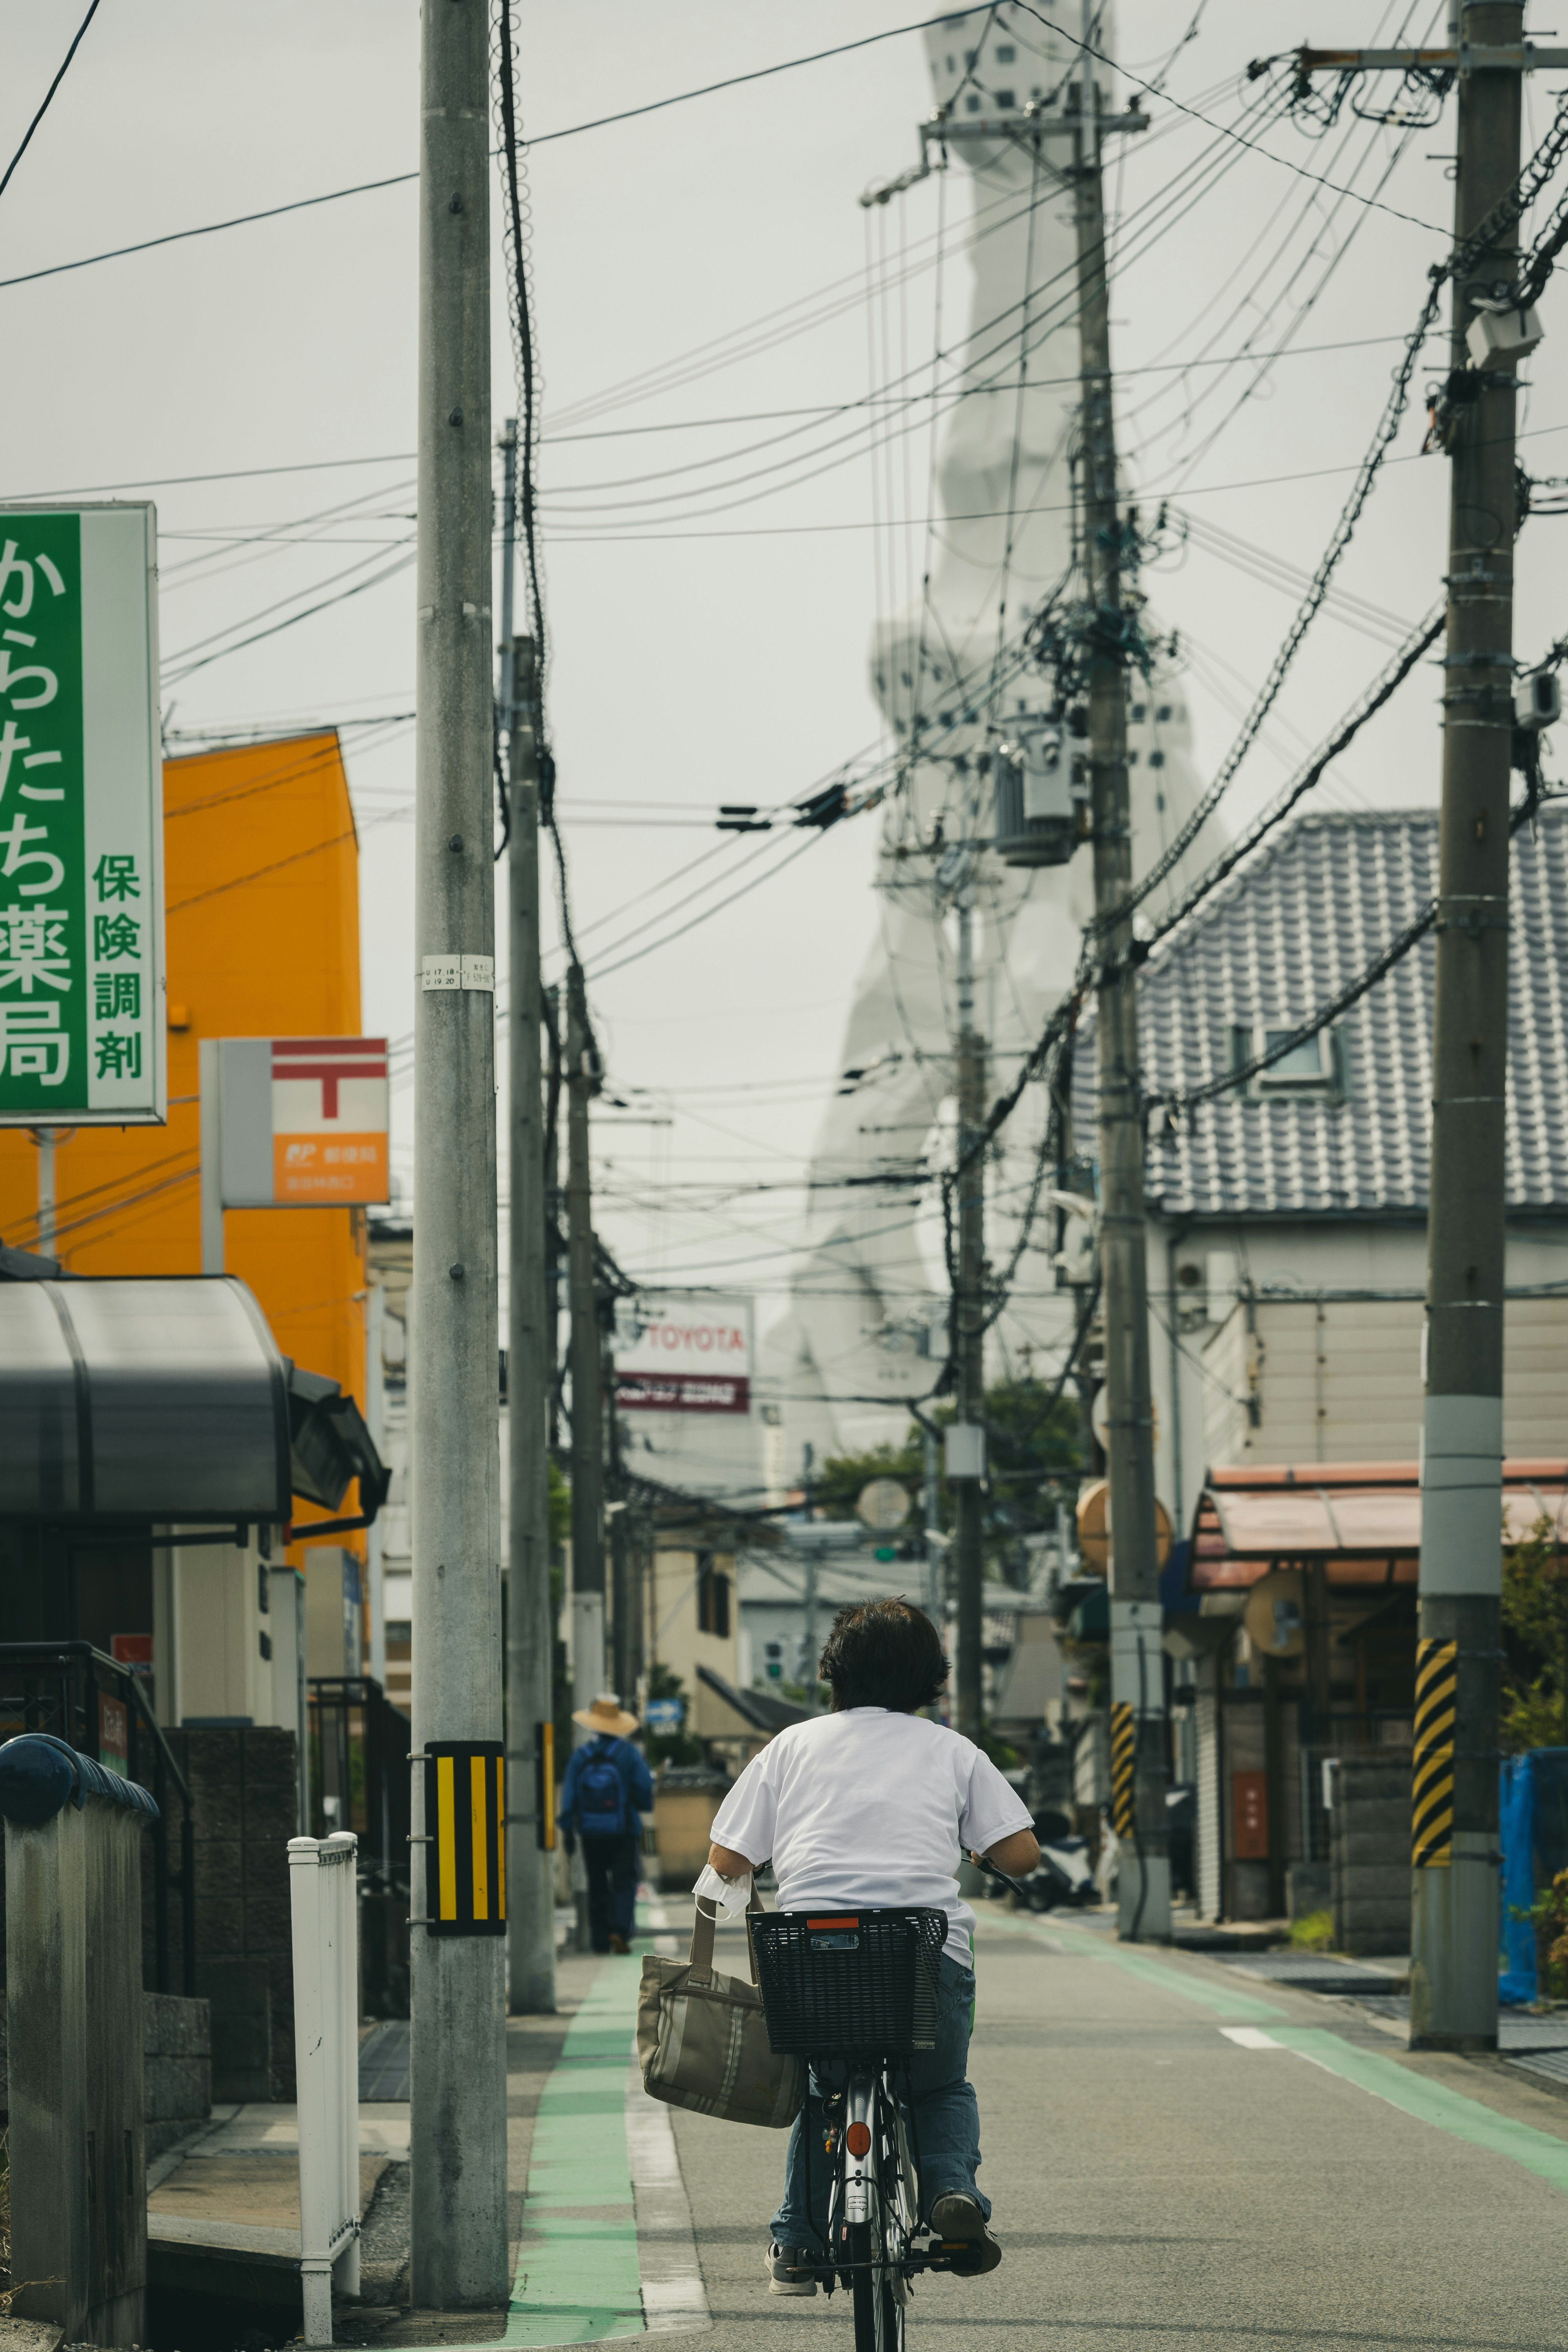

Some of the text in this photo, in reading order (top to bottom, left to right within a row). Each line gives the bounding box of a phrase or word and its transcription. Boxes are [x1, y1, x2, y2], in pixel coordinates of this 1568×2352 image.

[0, 539, 72, 1086] からたち薬局
[92, 855, 142, 1080] 保険調剤
[648, 1324, 743, 1351] TOYOTA
